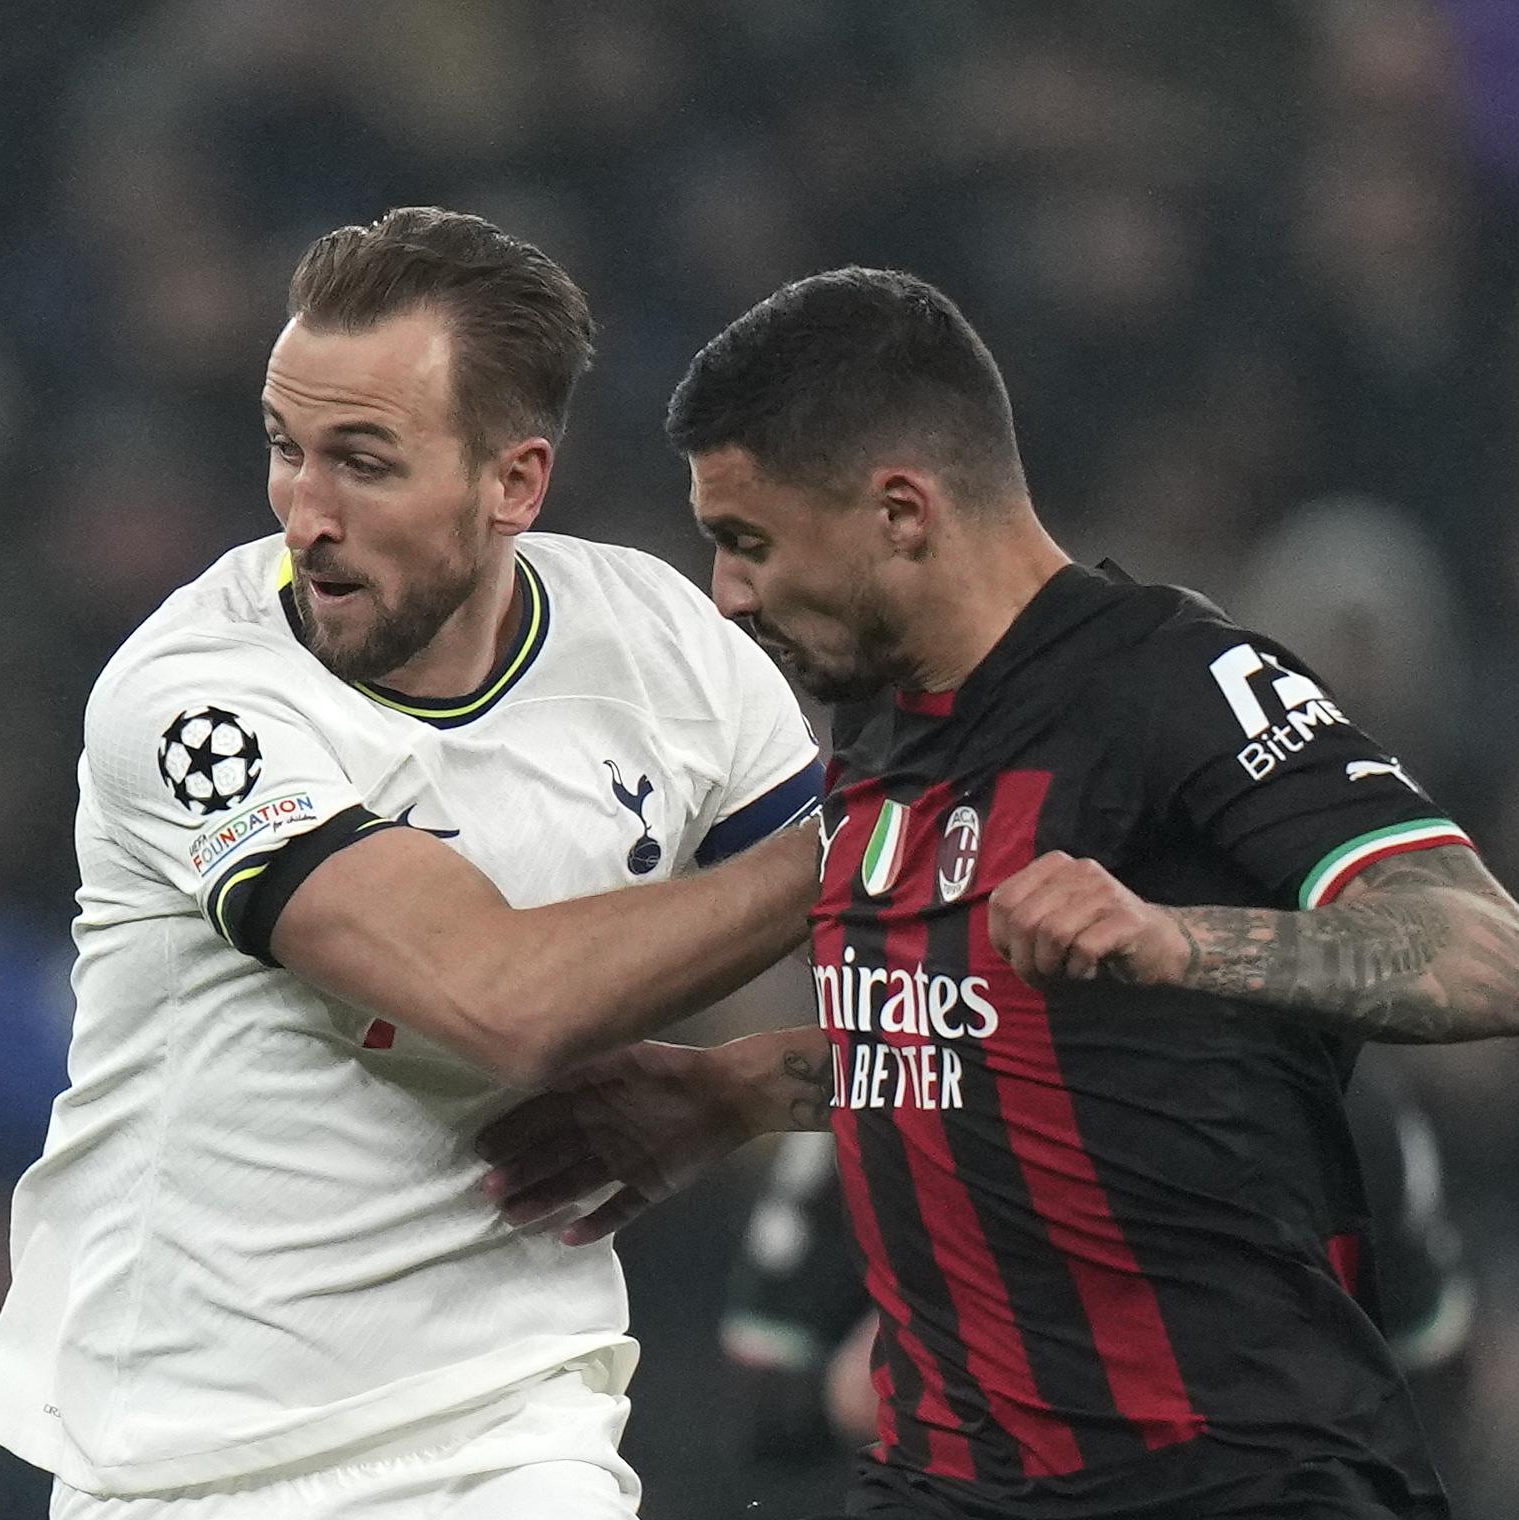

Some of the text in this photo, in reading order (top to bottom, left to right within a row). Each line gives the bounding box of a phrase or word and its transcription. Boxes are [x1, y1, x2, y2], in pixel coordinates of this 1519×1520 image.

[189, 833, 208, 857] UEFA
[192, 796, 313, 873] FOUNDATION
[808, 945, 999, 1039] mirates
